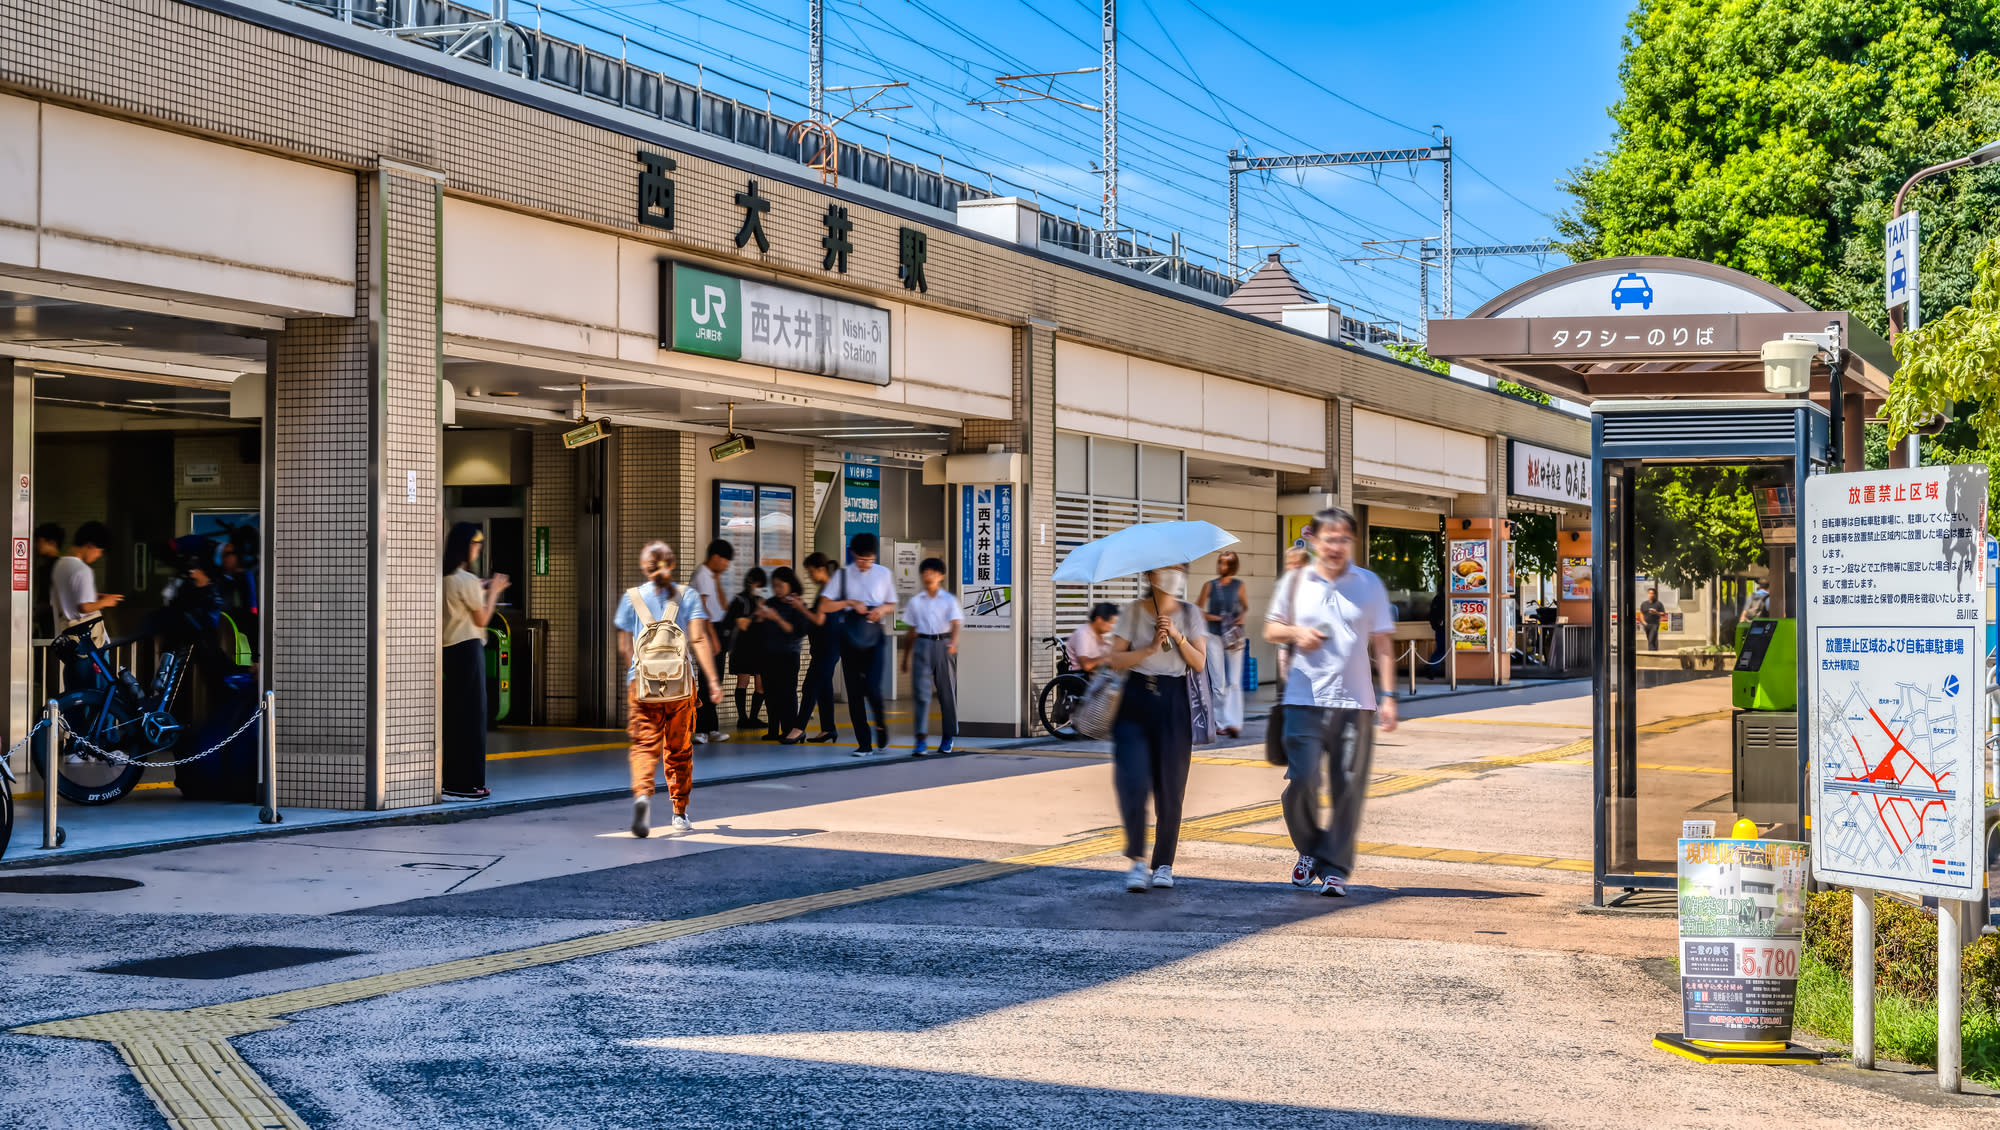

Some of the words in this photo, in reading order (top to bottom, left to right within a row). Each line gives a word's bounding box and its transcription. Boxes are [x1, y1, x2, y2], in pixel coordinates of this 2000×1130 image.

[638, 151, 928, 293] 西大井駅
[1888, 218, 1909, 248] TAXI
[691, 285, 727, 328] JR
[695, 328, 723, 342] JR東日本
[751, 301, 833, 355] 西大井駅
[842, 318, 882, 343] Nishi-Ōi
[1552, 327, 1714, 349] タクシーのりば
[842, 342, 877, 365] Station
[1848, 481, 1939, 504] 放置禁止区域
[1001, 487, 1010, 557] 不動産の相談窓口
[1813, 519, 1817, 528] 1
[977, 508, 990, 581] 西大井住販
[1812, 535, 1818, 543] 2
[1822, 528, 1972, 544] 自転車等を放置禁止区域内に放置した場合は撤去
[1822, 549, 1844, 558] します。
[1813, 565, 1818, 574] 3
[1822, 579, 1877, 589] 断して撤去します。
[1462, 603, 1483, 613] 350
[1813, 595, 1818, 604] 4
[1957, 609, 1979, 620] 品川区
[1826, 638, 1964, 654] 放置禁止区域および自転車駐車場
[1822, 659, 1860, 671] 西大井駅周辺
[101, 787, 121, 800] SWISS
[1686, 842, 1806, 867] 現地販売会開催中
[1742, 947, 1796, 978] 5,780
